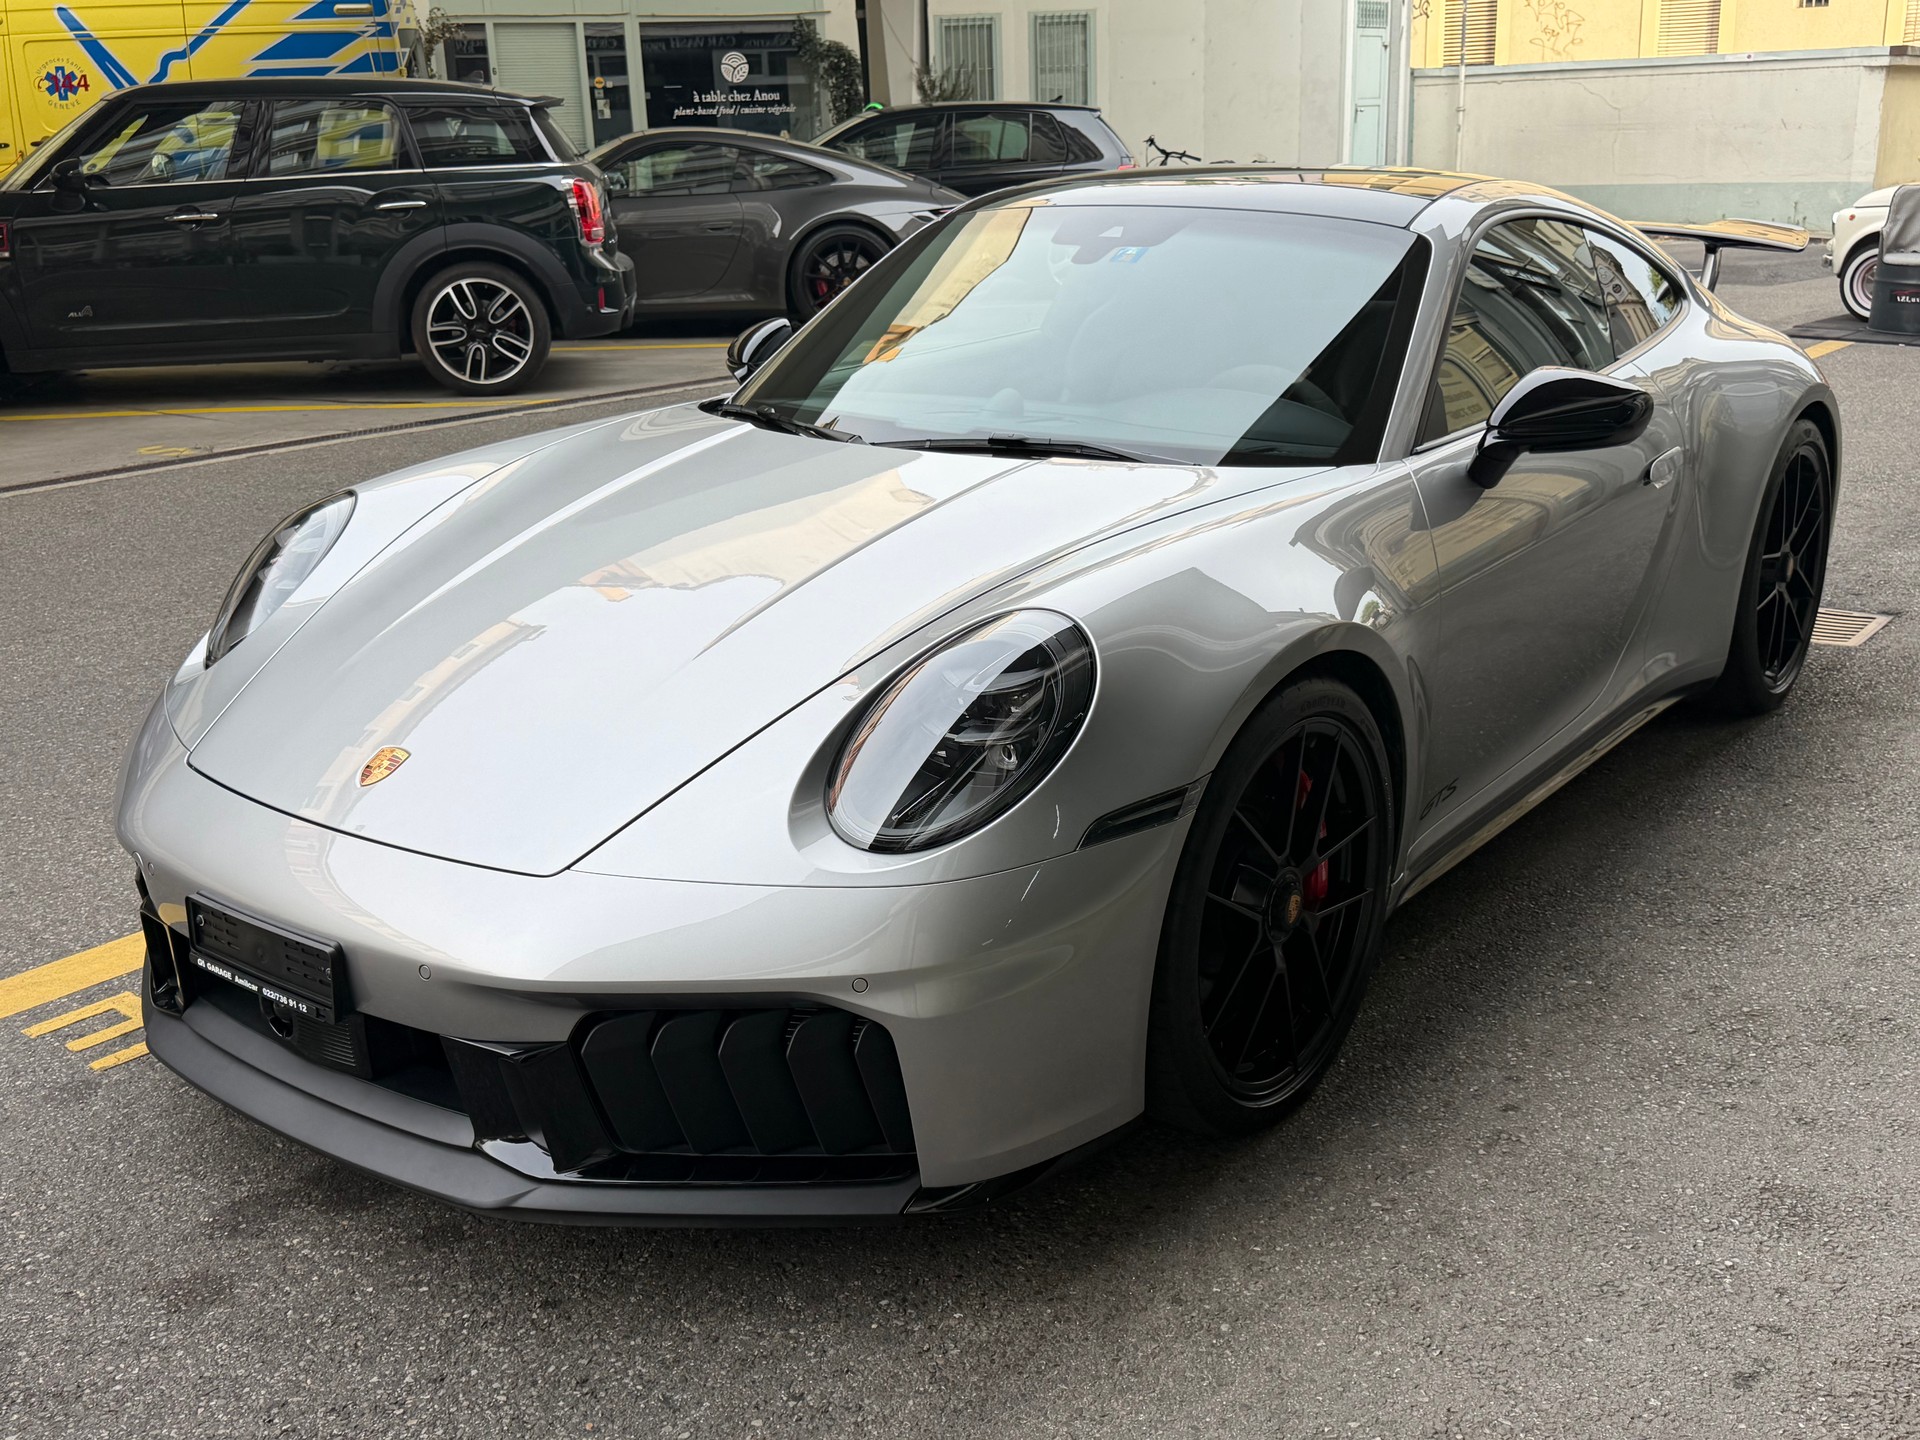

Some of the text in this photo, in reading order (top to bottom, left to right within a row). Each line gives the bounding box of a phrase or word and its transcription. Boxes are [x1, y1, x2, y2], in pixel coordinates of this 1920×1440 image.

[50, 73, 91, 92] 144
[692, 88, 781, 103] à table chez Anou
[672, 105, 719, 120] plant-based
[716, 104, 736, 118] food
[740, 103, 766, 114] cuisine
[767, 102, 797, 116] végétale
[1419, 776, 1460, 821] GTS
[206, 962, 233, 981] GARAGE
[234, 975, 259, 992] Amilcar
[262, 987, 288, 1005] 022/736
[288, 998, 298, 1009] 91
[298, 1002, 308, 1013] 12
